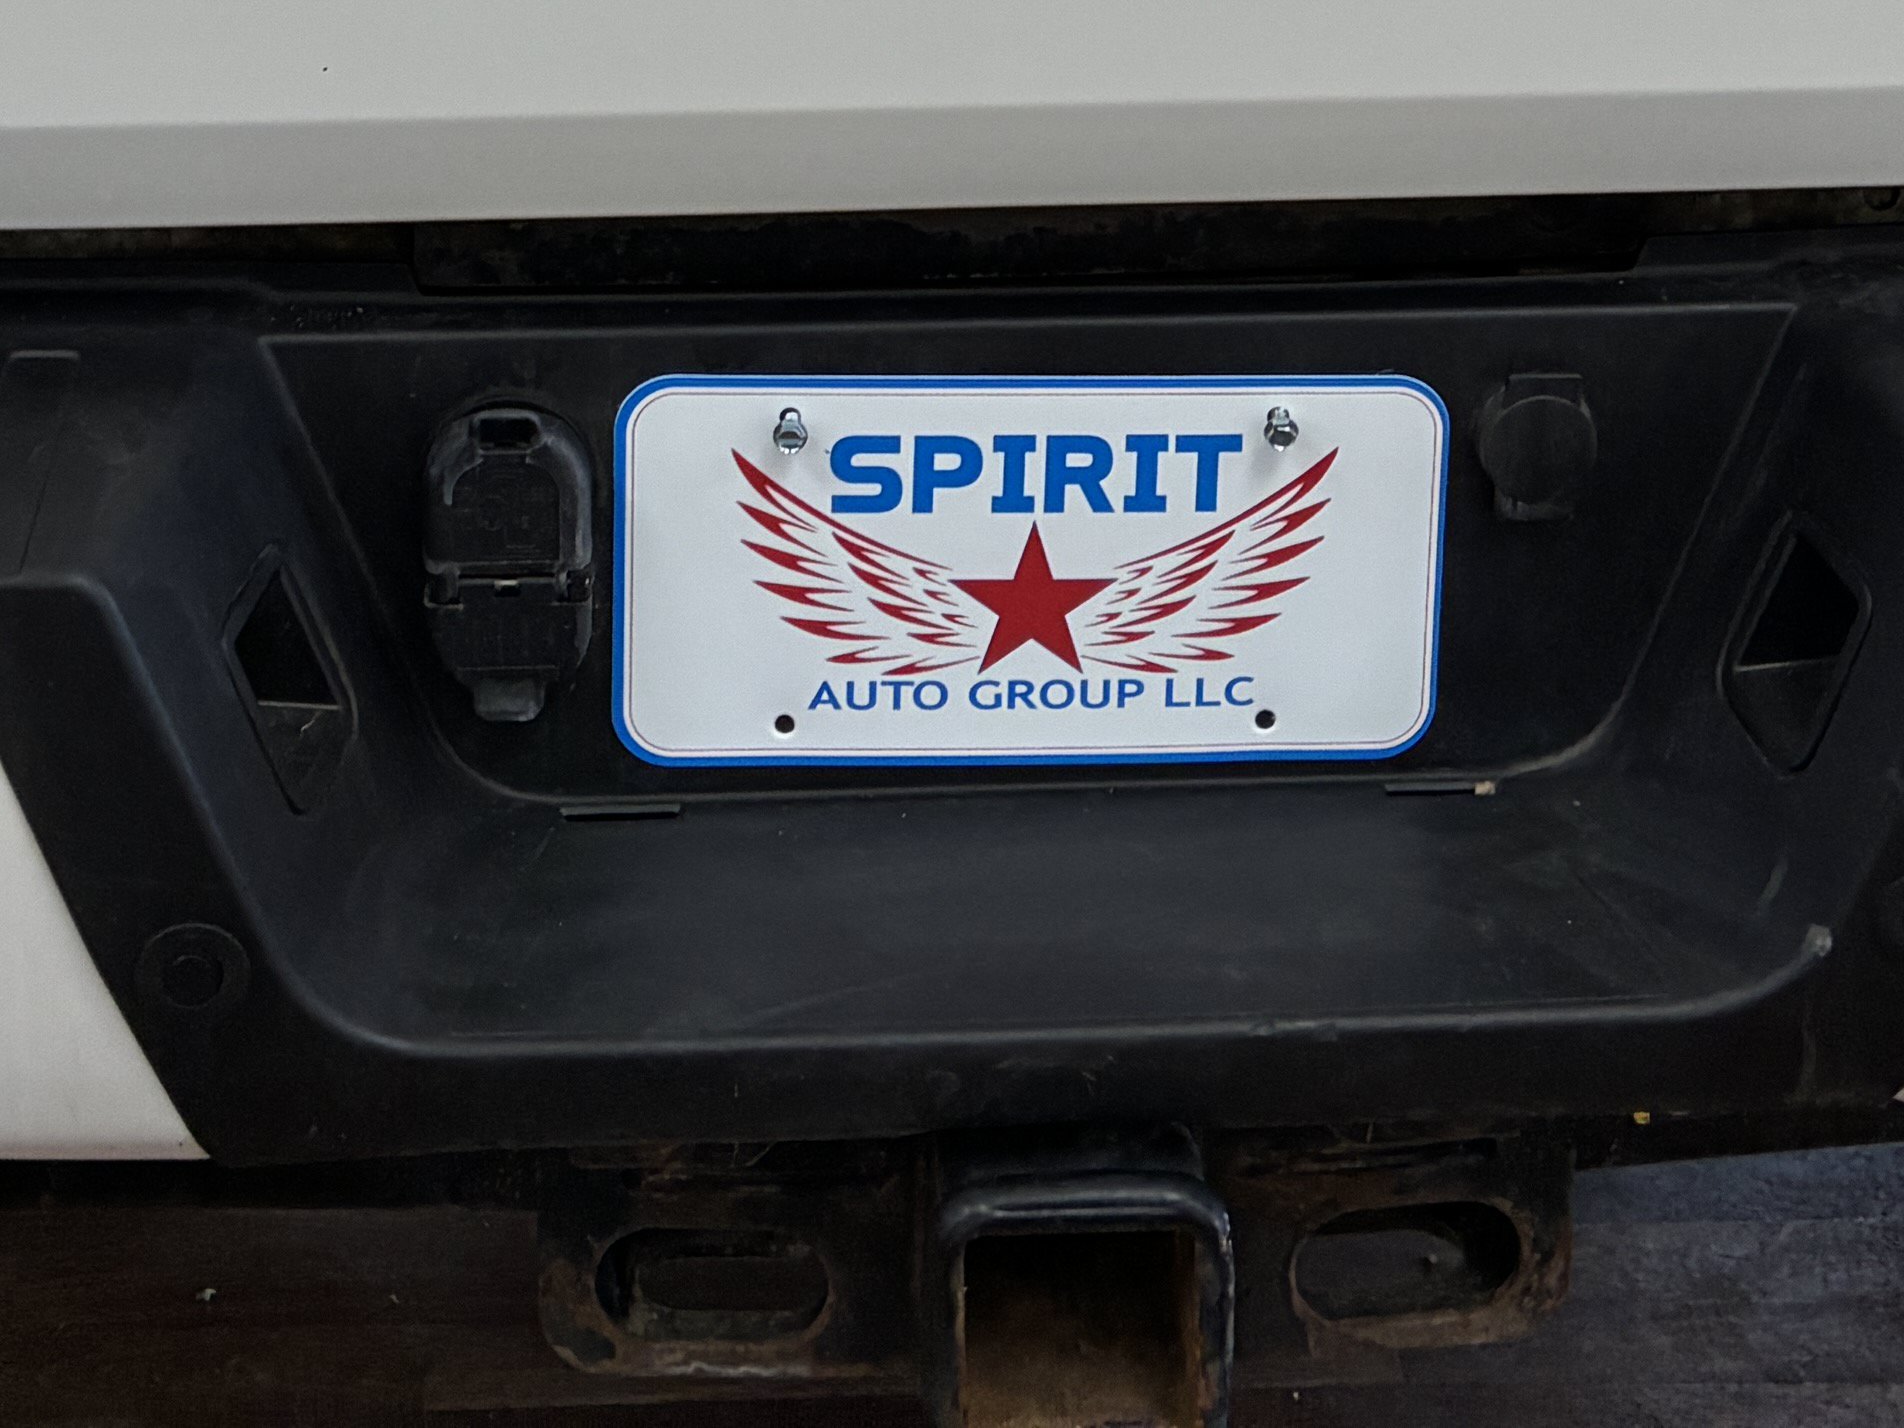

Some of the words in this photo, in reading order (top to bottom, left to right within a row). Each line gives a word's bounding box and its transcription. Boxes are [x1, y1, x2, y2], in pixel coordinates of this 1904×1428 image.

[828, 432, 1244, 516] SPIRIT
[807, 680, 949, 712] AUTO
[967, 677, 1146, 710] GROUP
[1164, 675, 1256, 708] LLC
